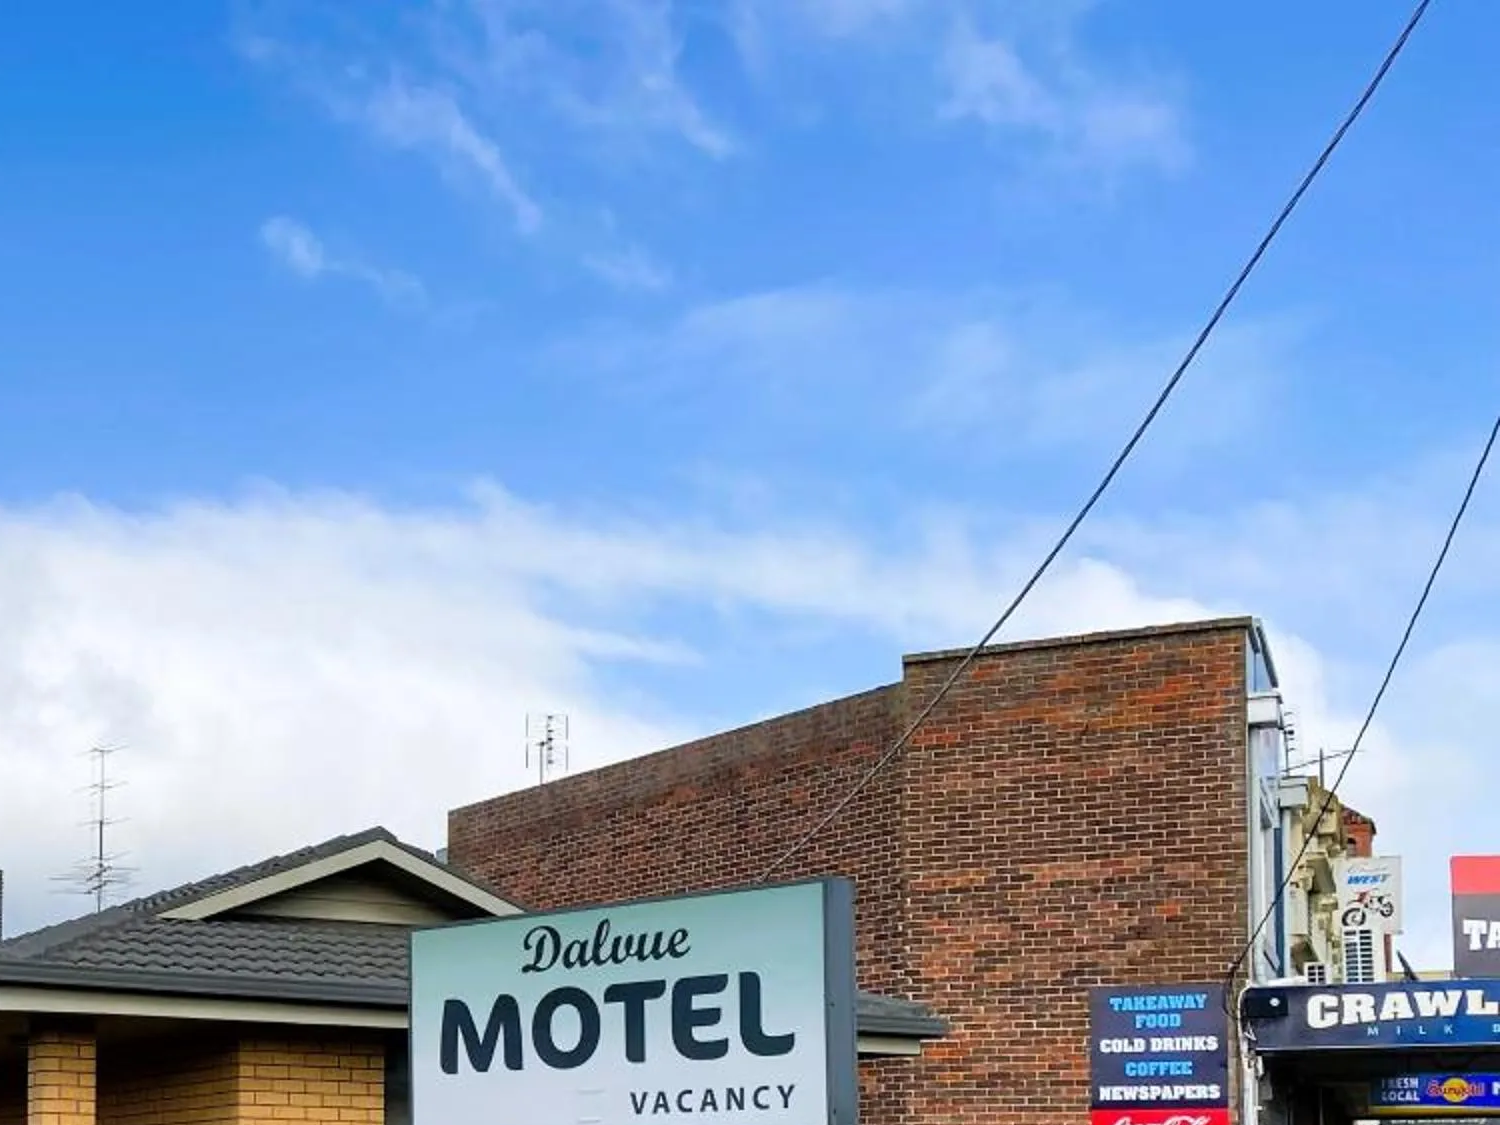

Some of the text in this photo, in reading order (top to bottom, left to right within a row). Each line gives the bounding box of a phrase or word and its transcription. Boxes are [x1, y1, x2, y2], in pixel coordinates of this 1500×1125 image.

[520, 918, 692, 974] Dalvue
[1109, 994, 1207, 1011] TAKEAWAY
[1307, 989, 1499, 1029] CRAWL
[439, 971, 796, 1075] MOTEL
[1135, 1013, 1181, 1029] FOOD
[1367, 1023, 1453, 1037] MILK
[1100, 1035, 1219, 1054] COLD DRINKS
[1125, 1060, 1193, 1077] COFFEE
[1381, 1077, 1419, 1089] FRESH
[630, 1084, 797, 1116] VACANCY
[1099, 1085, 1221, 1101] NEWSPAPERS
[1381, 1090, 1420, 1102] LOCAL
